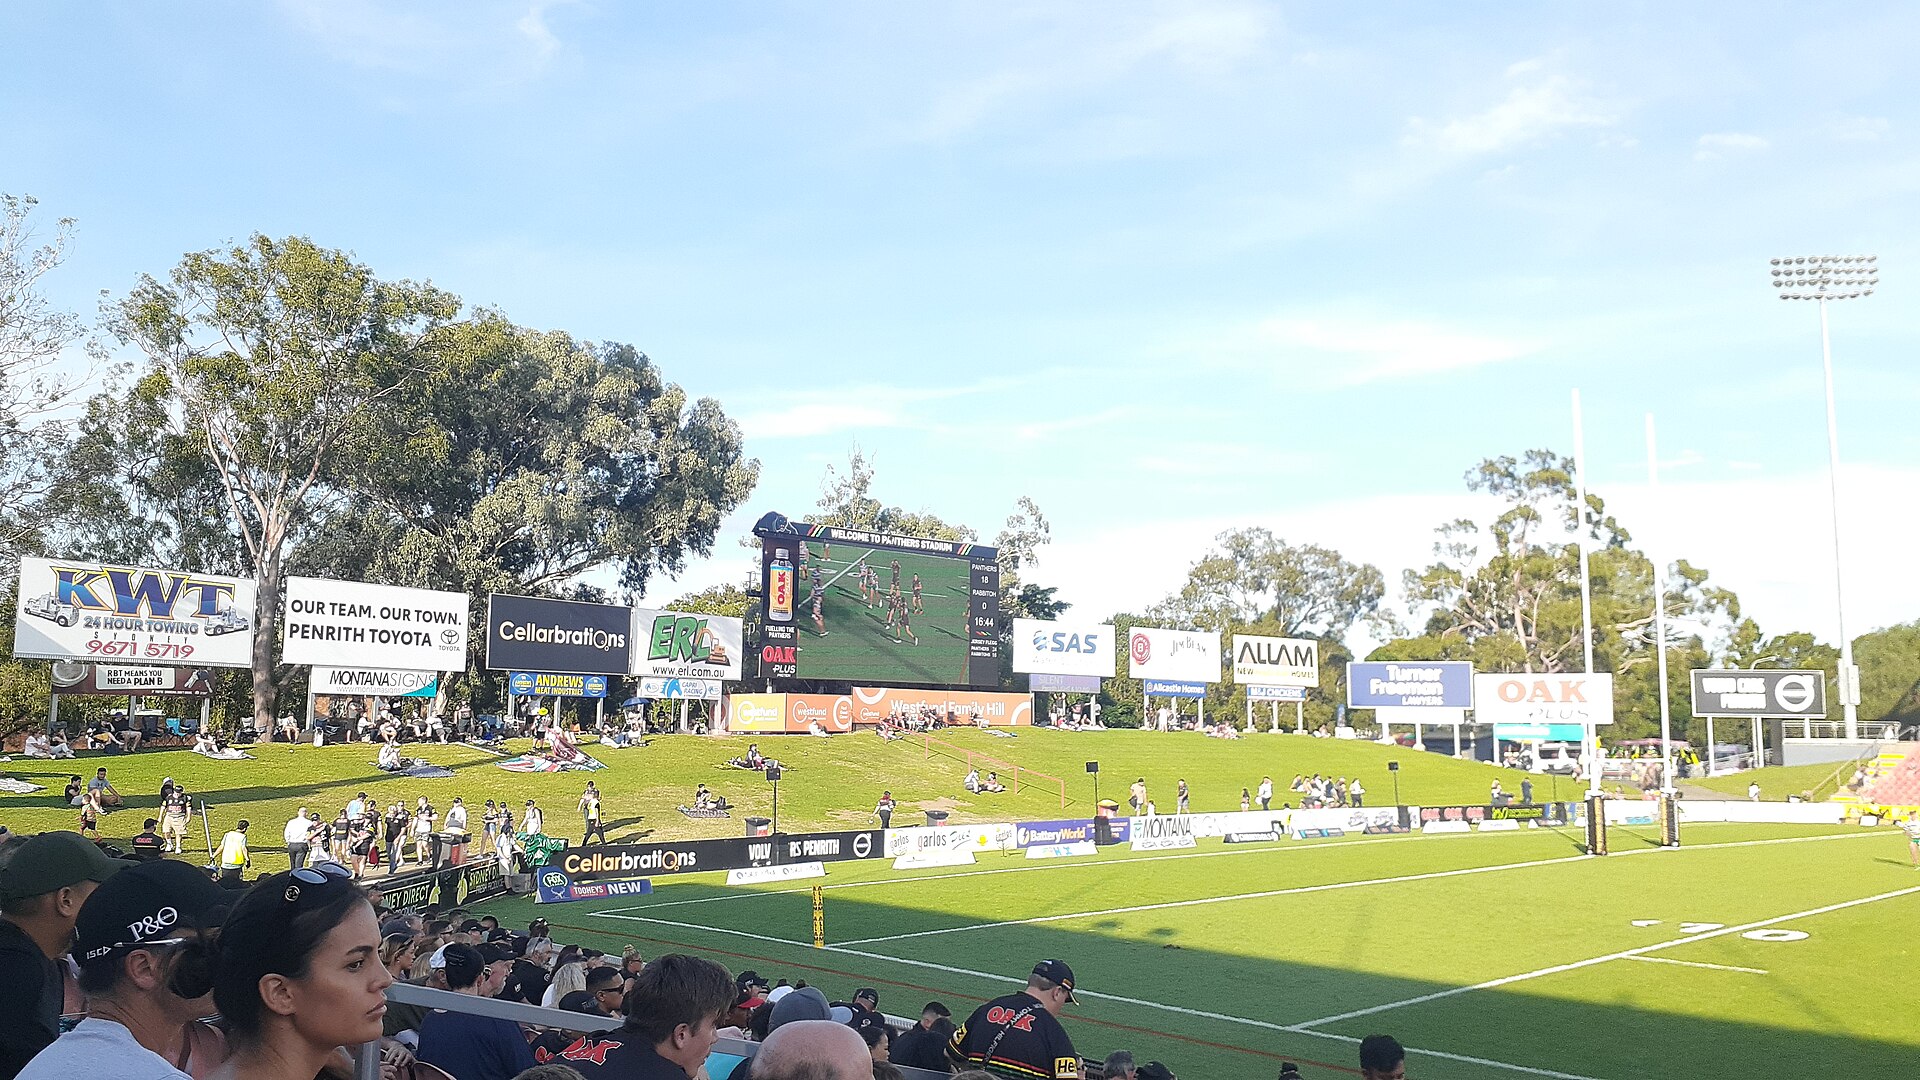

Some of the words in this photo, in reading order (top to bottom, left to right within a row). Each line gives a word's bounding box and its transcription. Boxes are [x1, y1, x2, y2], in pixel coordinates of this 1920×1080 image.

[831, 528, 869, 542] WELCOME
[870, 533, 880, 543] TO
[881, 535, 920, 549] PANTHERS
[920, 541, 953, 552] STADIUM
[971, 563, 998, 572] PANTHERS
[778, 571, 786, 605] OAK
[981, 576, 989, 584] 18
[50, 565, 236, 620] KWT
[290, 599, 326, 615] OUR
[329, 602, 376, 619] TEAM.
[380, 606, 411, 622] OUR
[414, 609, 462, 626] TOWN.
[982, 602, 987, 610] 0
[83, 616, 102, 630] 24
[103, 617, 144, 632] HOUR
[145, 619, 199, 634] TOWING
[974, 616, 994, 627] 16:44
[94, 631, 188, 644] SYDNEY
[289, 623, 365, 643] PENRITH
[369, 628, 432, 647] TOYOTA
[499, 621, 626, 651] Cellarbrations
[648, 615, 711, 665] ERL
[768, 631, 791, 639] PANTHERS
[1050, 632, 1098, 654] SAS
[86, 640, 137, 656] 9671
[144, 643, 194, 659] 5719
[762, 645, 796, 663] OAK
[1238, 641, 1313, 667] ALLAM
[652, 665, 725, 678] www.erl.com.au
[1237, 667, 1254, 675] NEW
[1385, 664, 1443, 681] Turner
[107, 677, 126, 685] NEED
[134, 677, 155, 686] PLAN
[157, 677, 163, 685] B
[535, 674, 584, 688] ANDREWS
[1181, 684, 1205, 694] Homes
[1369, 678, 1444, 696] Freeman
[534, 687, 551, 695] MEAT
[551, 687, 584, 696] INDUSTRIES
[1401, 695, 1444, 706] LAWYERS
[1497, 680, 1588, 703] OAK
[797, 707, 827, 716] westfund
[890, 700, 946, 715] Westfund
[948, 701, 985, 716] Family
[986, 702, 1005, 715] Hill
[748, 843, 772, 861] VOLV
[789, 841, 801, 858] RS
[803, 839, 840, 856] PENRITH
[564, 850, 697, 874] Cellarbrations
[546, 874, 564, 884] FOX
[573, 885, 604, 895] TOOHEYS
[607, 881, 641, 895] NEW
[402, 884, 430, 907] DIRECT
[127, 906, 178, 943] P&O
[987, 1005, 1036, 1032] OAK
[1010, 1006, 1033, 1026] TOMMY
